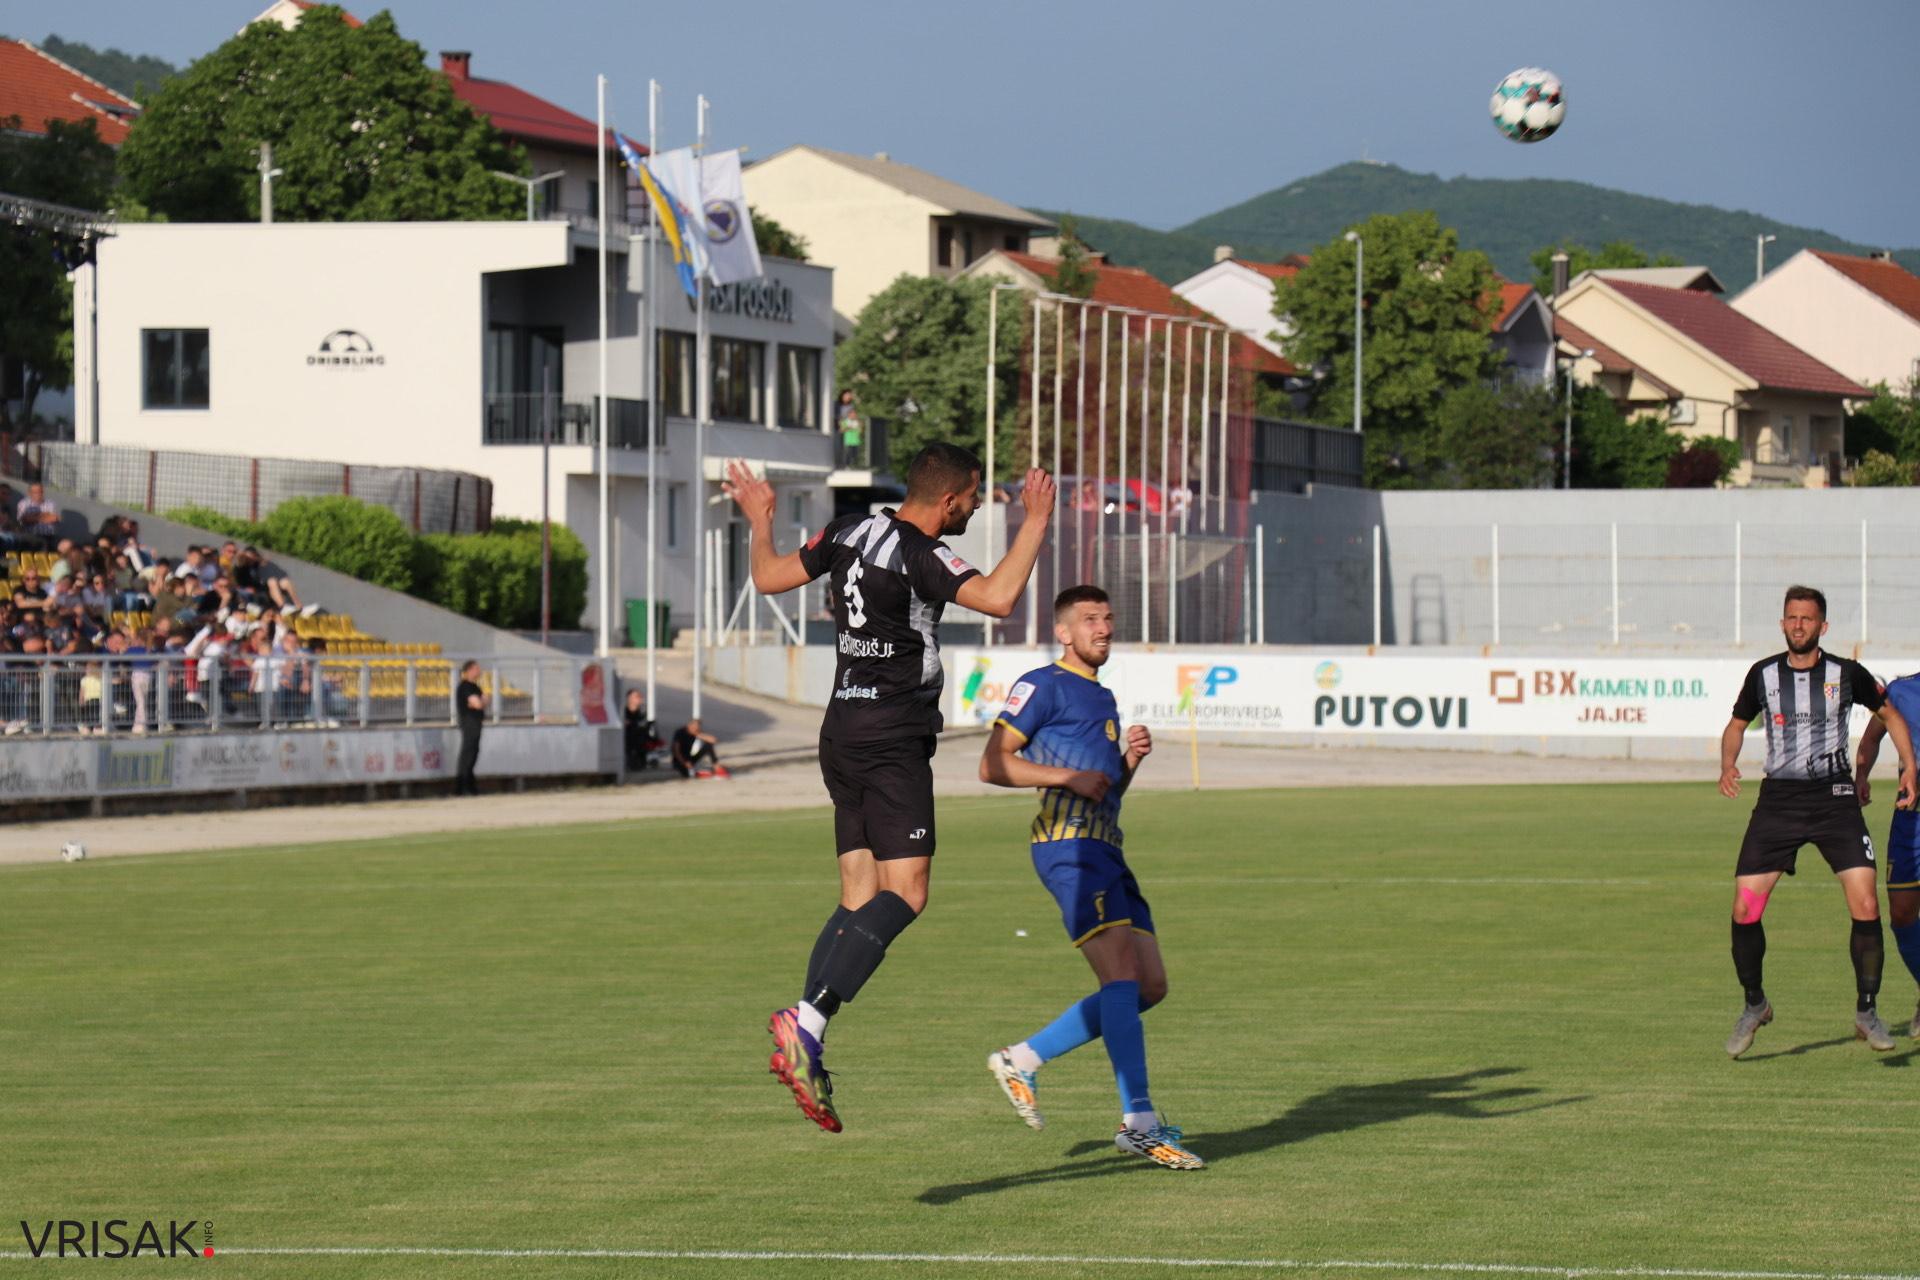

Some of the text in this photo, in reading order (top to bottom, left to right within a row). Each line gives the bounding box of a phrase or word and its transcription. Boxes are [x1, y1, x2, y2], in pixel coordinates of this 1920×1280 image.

[306, 355, 384, 366] DRIBBLING
[1579, 679, 1648, 697] KAMEN
[1654, 679, 1709, 698] D.O.O.
[1133, 704, 1148, 718] JP
[1314, 695, 1468, 728] PUTOVI
[1578, 707, 1647, 723] JAJCE
[1105, 719, 1117, 742] 9
[1863, 835, 1874, 861] 3
